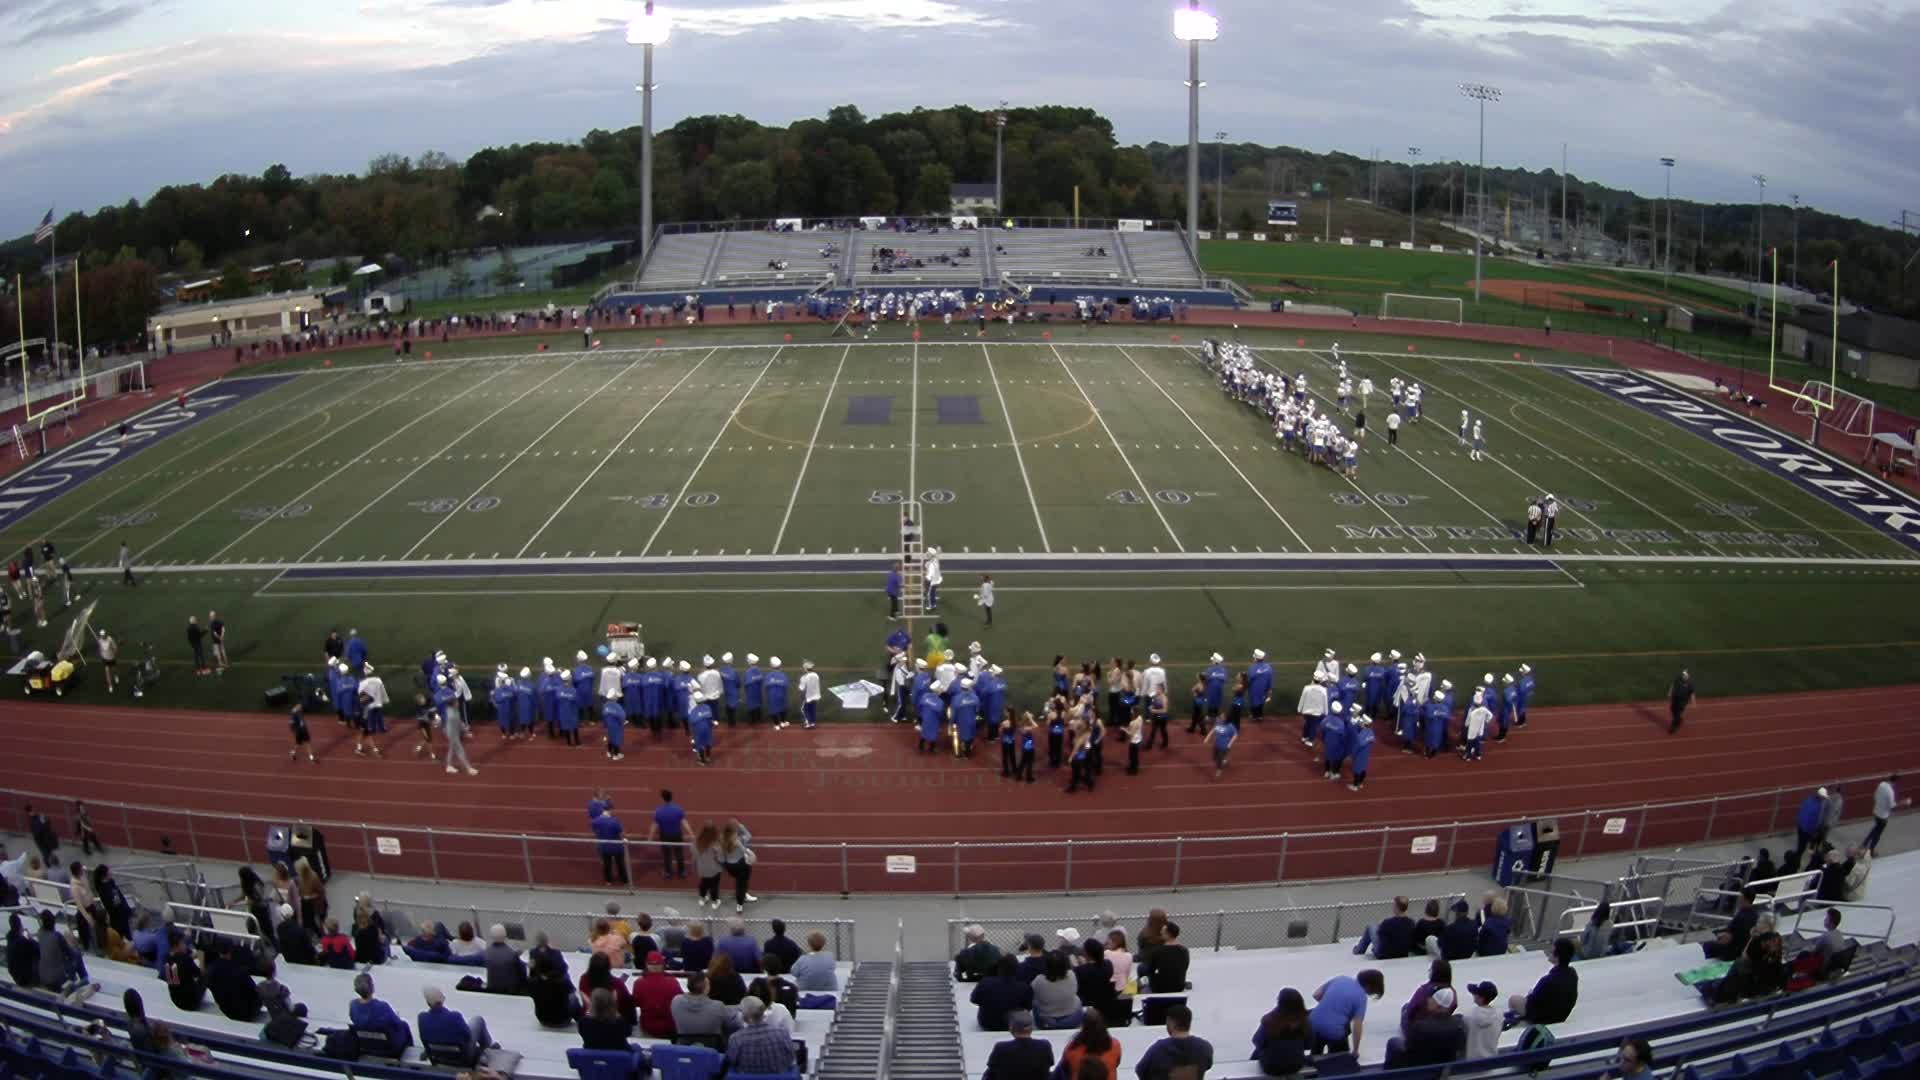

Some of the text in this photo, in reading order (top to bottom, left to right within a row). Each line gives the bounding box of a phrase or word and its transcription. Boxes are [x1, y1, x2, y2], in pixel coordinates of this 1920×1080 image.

[1565, 369, 1920, 546] EXPLORER
[868, 489, 956, 504] 50
[1106, 488, 1191, 504] 40
